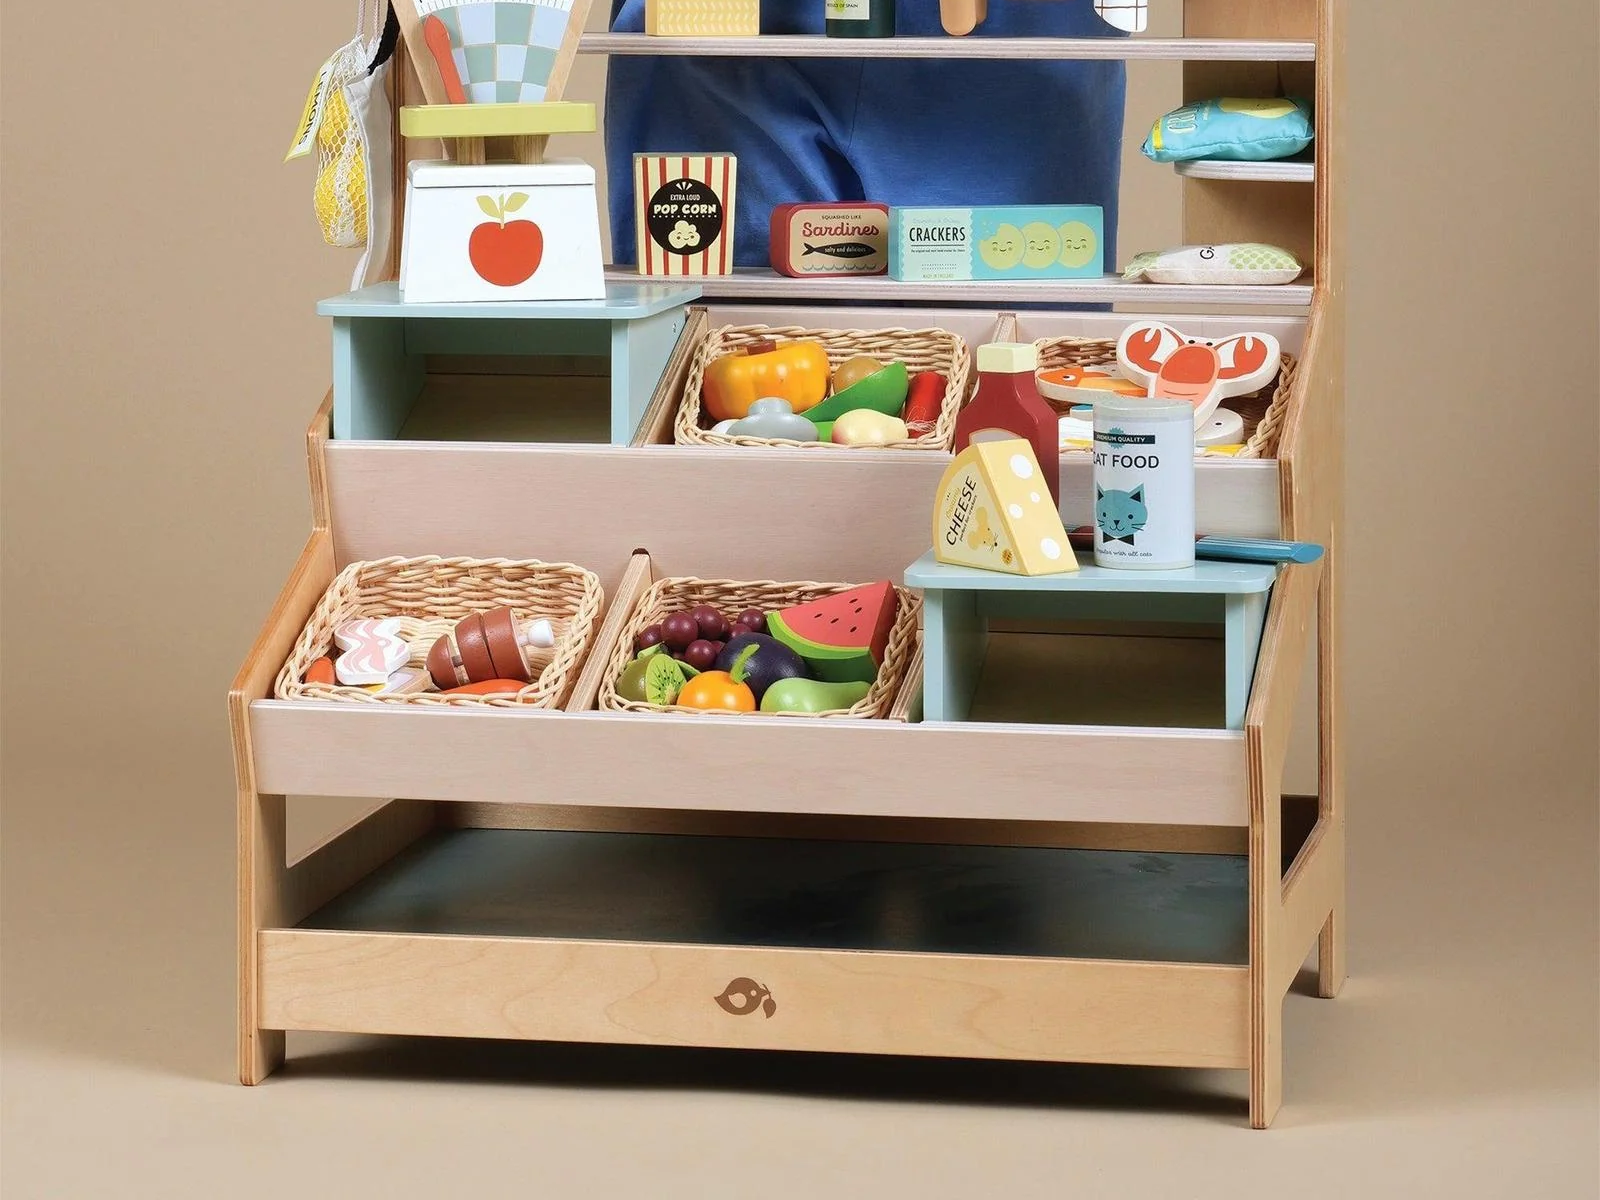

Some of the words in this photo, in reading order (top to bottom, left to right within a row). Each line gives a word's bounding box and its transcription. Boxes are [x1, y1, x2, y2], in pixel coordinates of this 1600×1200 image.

[653, 204, 679, 215] POP
[681, 203, 717, 215] CORN
[802, 221, 879, 237] Sardines
[909, 226, 966, 242] CRACKERS
[1200, 246, 1214, 259] G
[1112, 454, 1160, 469] FOOD
[945, 475, 977, 546] CHEESE
